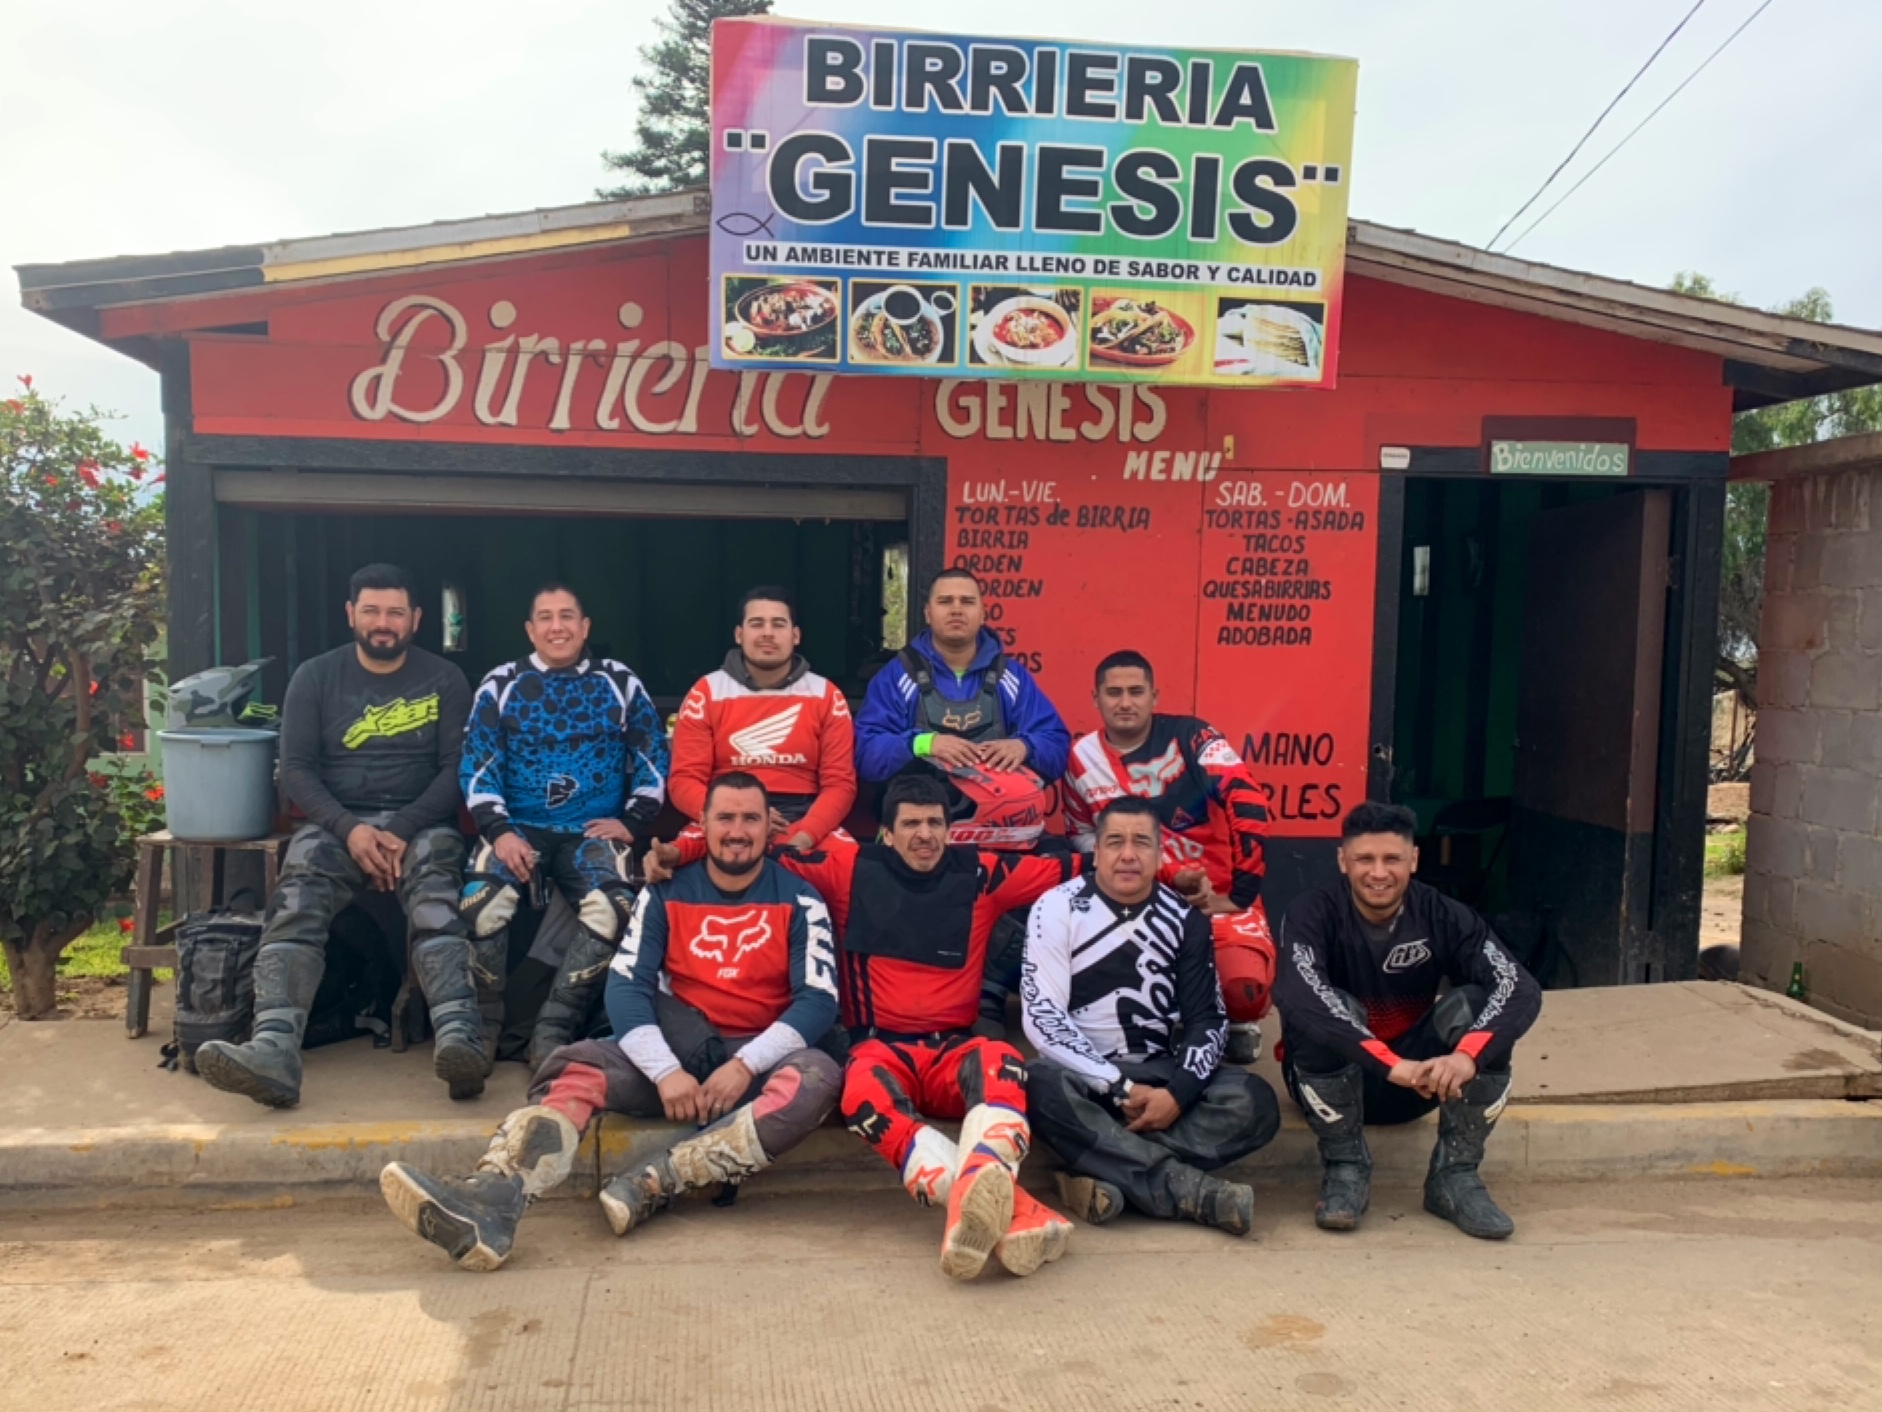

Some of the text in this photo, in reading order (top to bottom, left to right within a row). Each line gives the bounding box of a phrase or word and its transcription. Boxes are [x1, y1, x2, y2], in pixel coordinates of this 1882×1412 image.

[806, 36, 1276, 131] BIRRIERIA
[745, 244, 1317, 287] UN AMBIENTE FAMILIAR LLENO DE SABOR Y CALIDAD
[1122, 450, 1223, 482] MENU
[1495, 442, 1625, 472] Bienvenidos
[955, 502, 1151, 532] TORTAS de BIRRIA
[1205, 509, 1281, 529] TORTAS
[956, 528, 1030, 549] BIRRIA
[1242, 533, 1307, 554] TACOS
[953, 554, 1023, 573] ORDEN
[1226, 556, 1309, 577] CABEZA
[1202, 578, 1332, 600] QUESABIRRIAS
[1226, 602, 1311, 622] MENUDO
[1217, 626, 1313, 646] ADOBADA
[1241, 731, 1335, 767] MANO
[730, 753, 808, 767] HONDA
[717, 968, 741, 979] FOX
